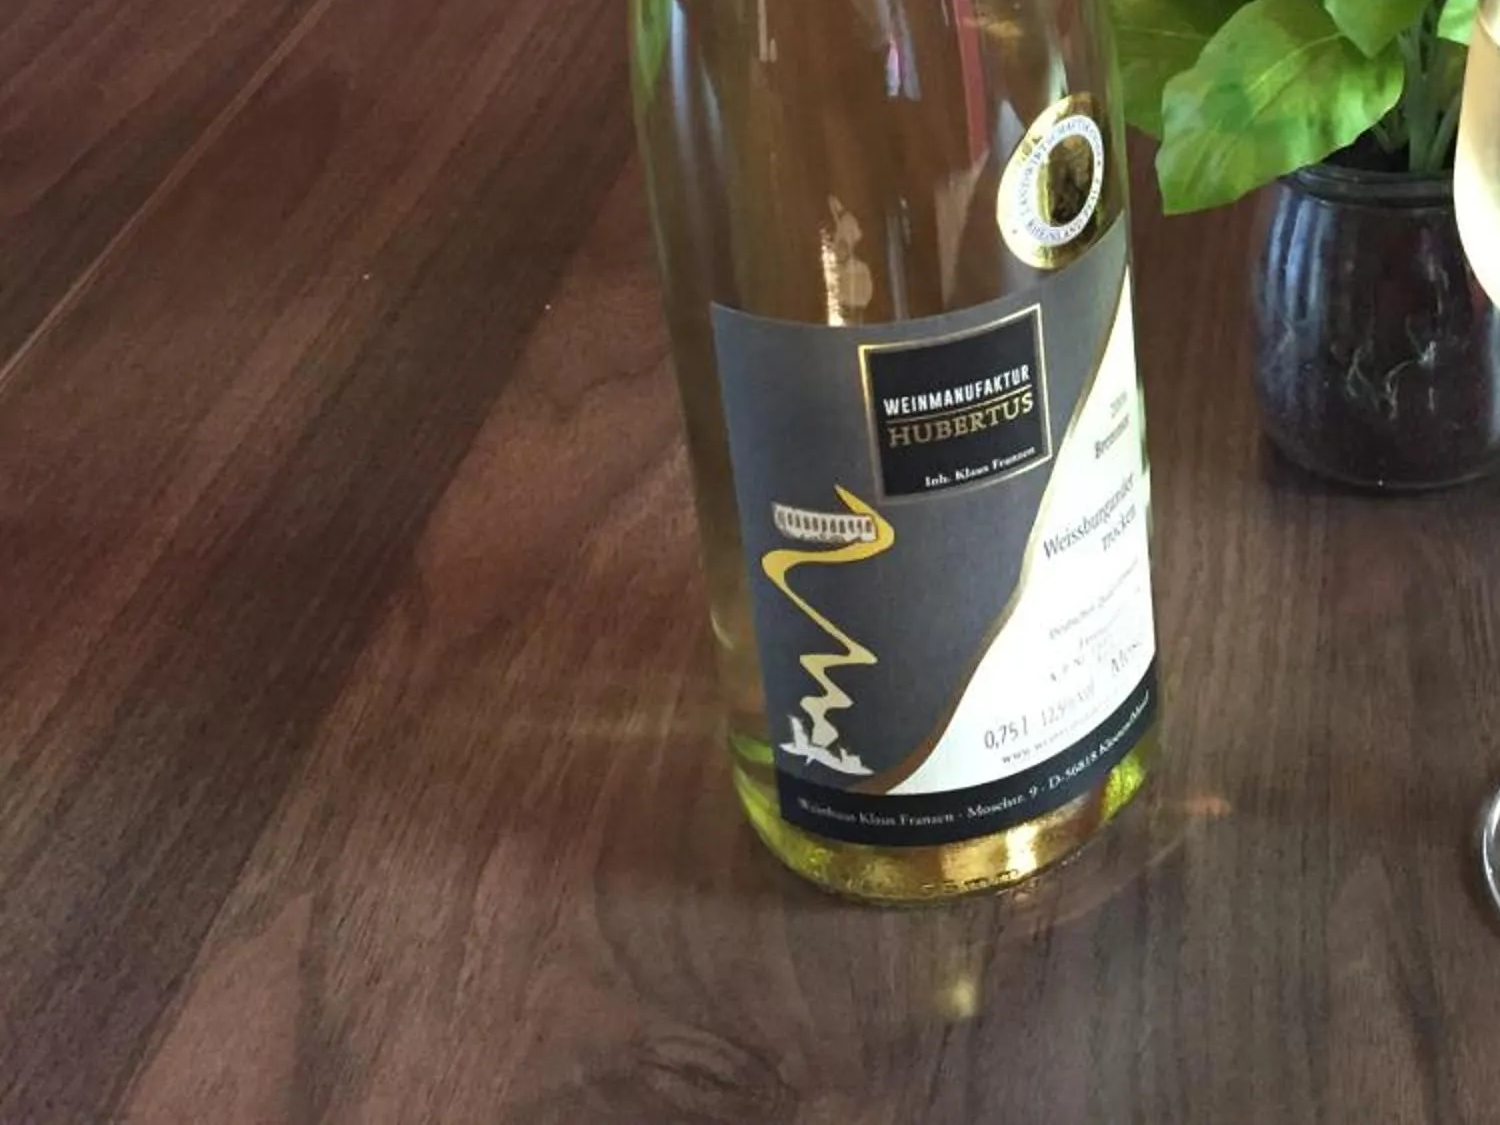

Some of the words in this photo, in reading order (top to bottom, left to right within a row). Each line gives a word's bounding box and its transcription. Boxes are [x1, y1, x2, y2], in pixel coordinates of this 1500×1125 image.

[882, 363, 1031, 416] WEINMANUFAKTUR
[887, 391, 1034, 448] HUBERTUS
[955, 467, 990, 481] Klaus
[984, 722, 1019, 750] 0,75
[858, 811, 897, 826] Klaus
[1028, 786, 1039, 799] 9
